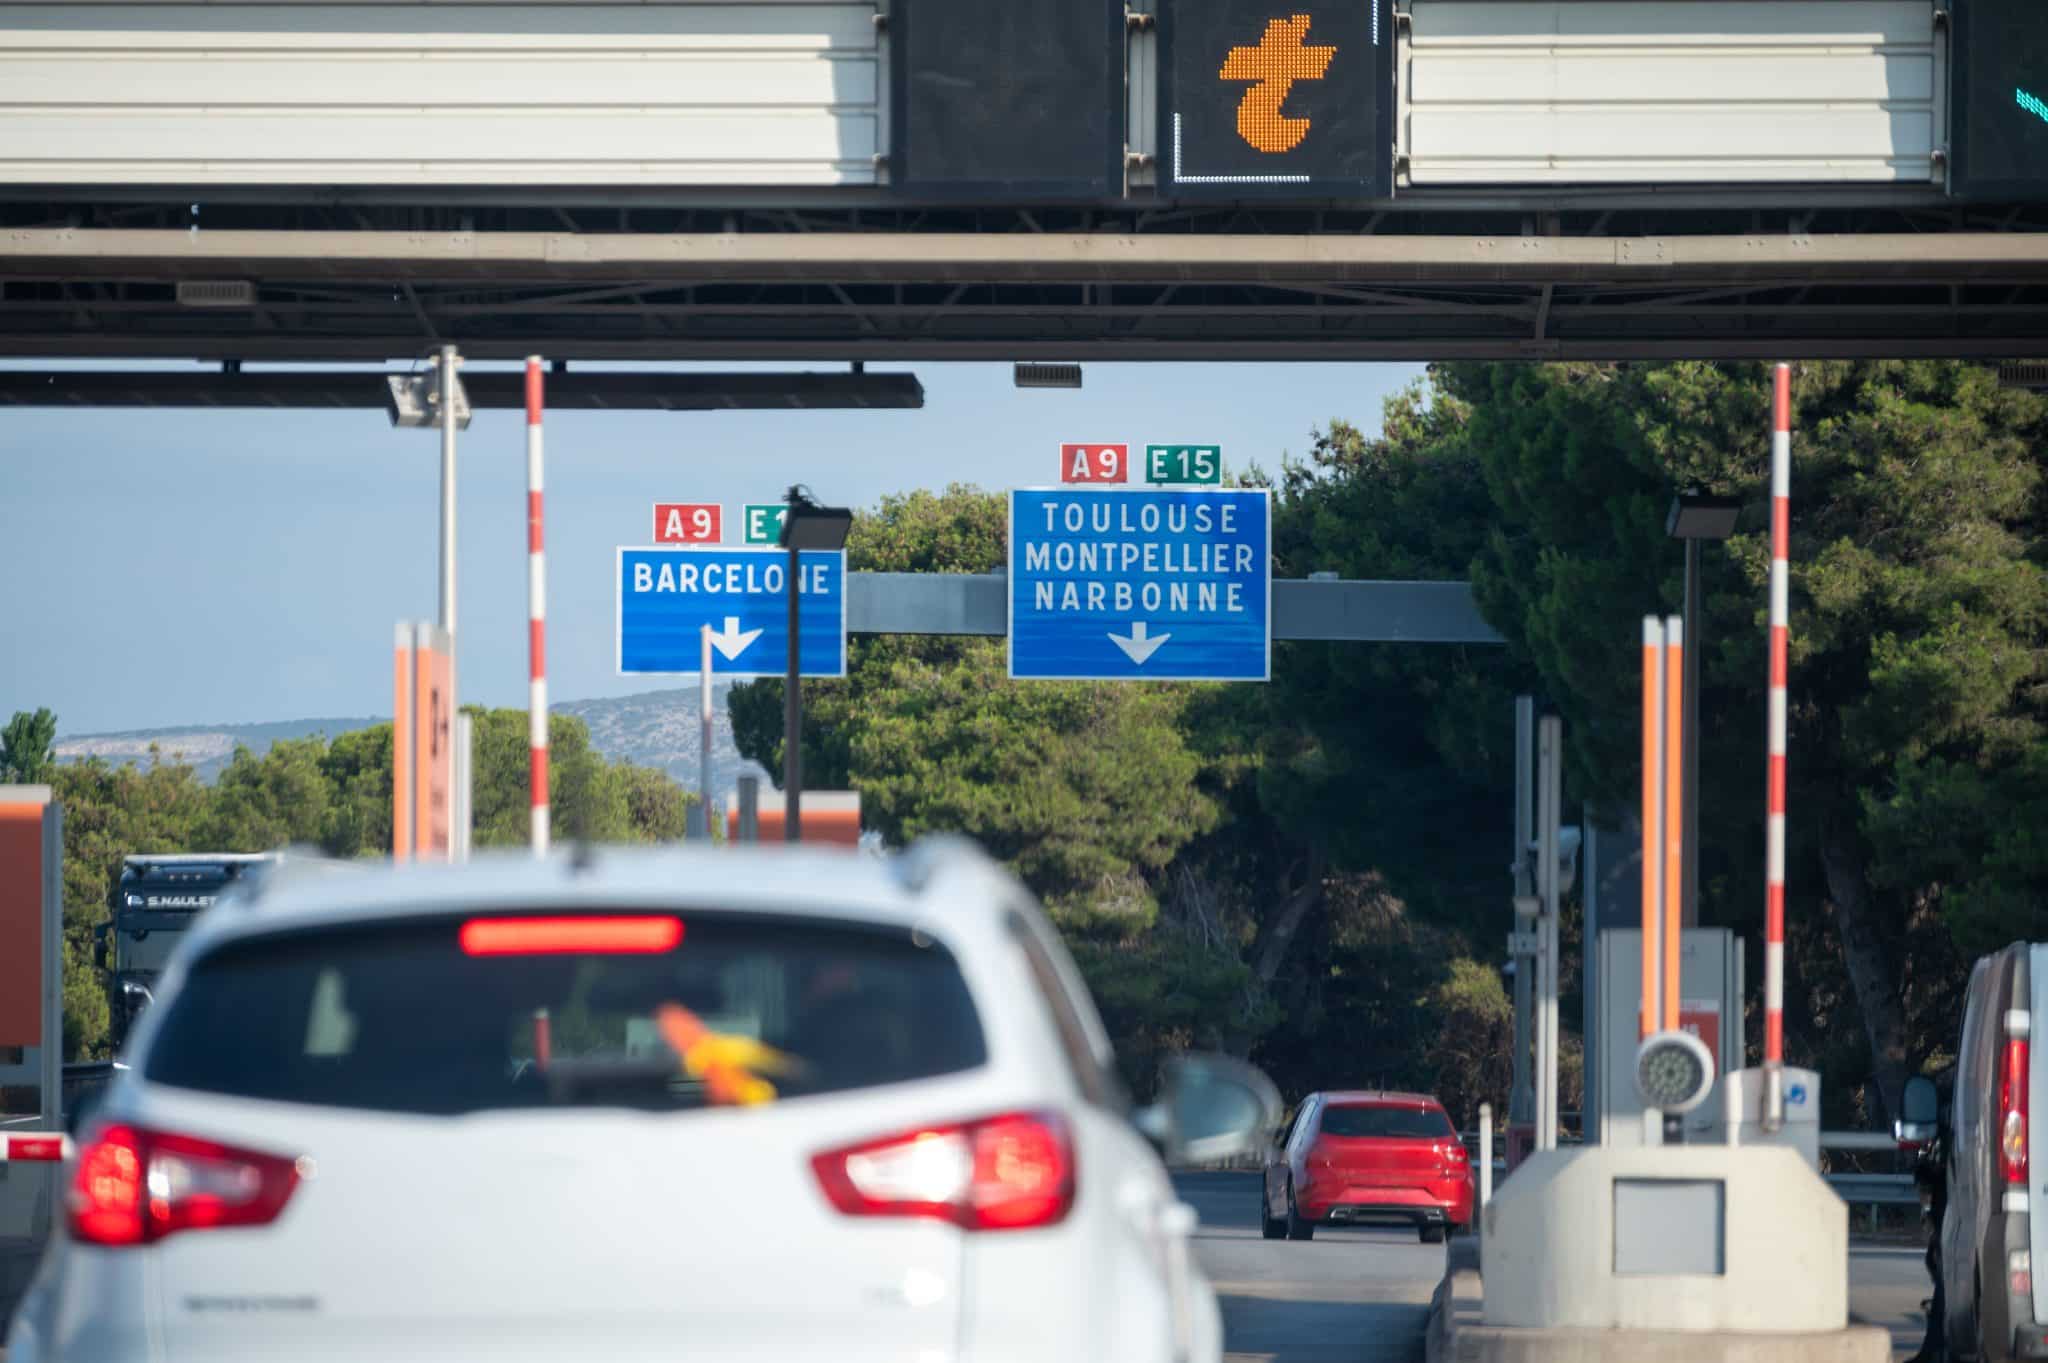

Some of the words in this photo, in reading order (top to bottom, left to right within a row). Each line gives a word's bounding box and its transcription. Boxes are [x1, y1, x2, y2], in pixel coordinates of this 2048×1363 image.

[1042, 502, 1238, 533] TOULOUSE
[1025, 542, 1254, 573] MONTPELLIER
[1035, 581, 1244, 613] NARBONNE
